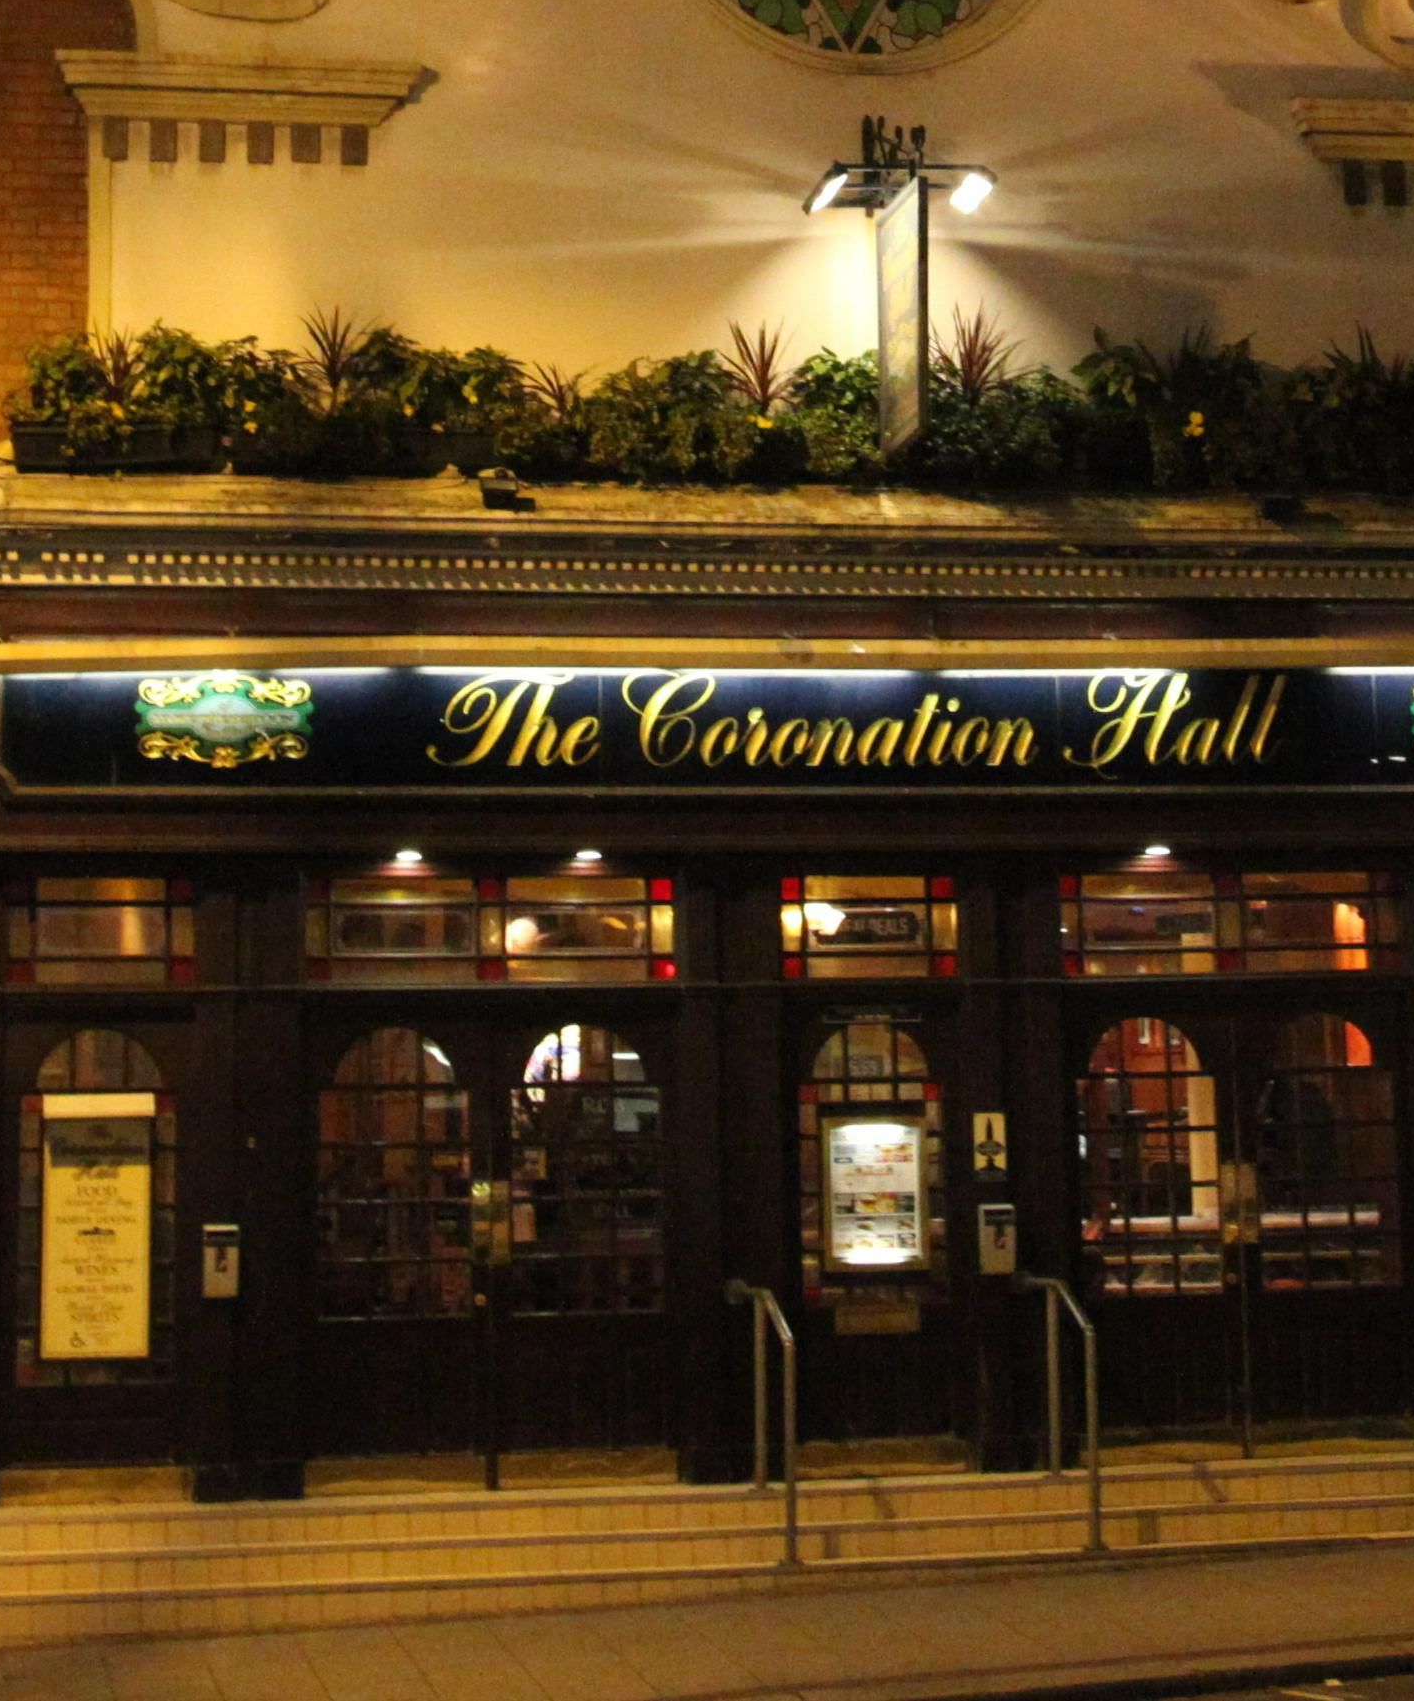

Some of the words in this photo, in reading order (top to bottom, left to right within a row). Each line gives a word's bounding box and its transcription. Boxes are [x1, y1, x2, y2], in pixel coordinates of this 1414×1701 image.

[424, 671, 602, 768] The
[622, 669, 1038, 768] Coronation
[1063, 669, 1285, 780] Hall
